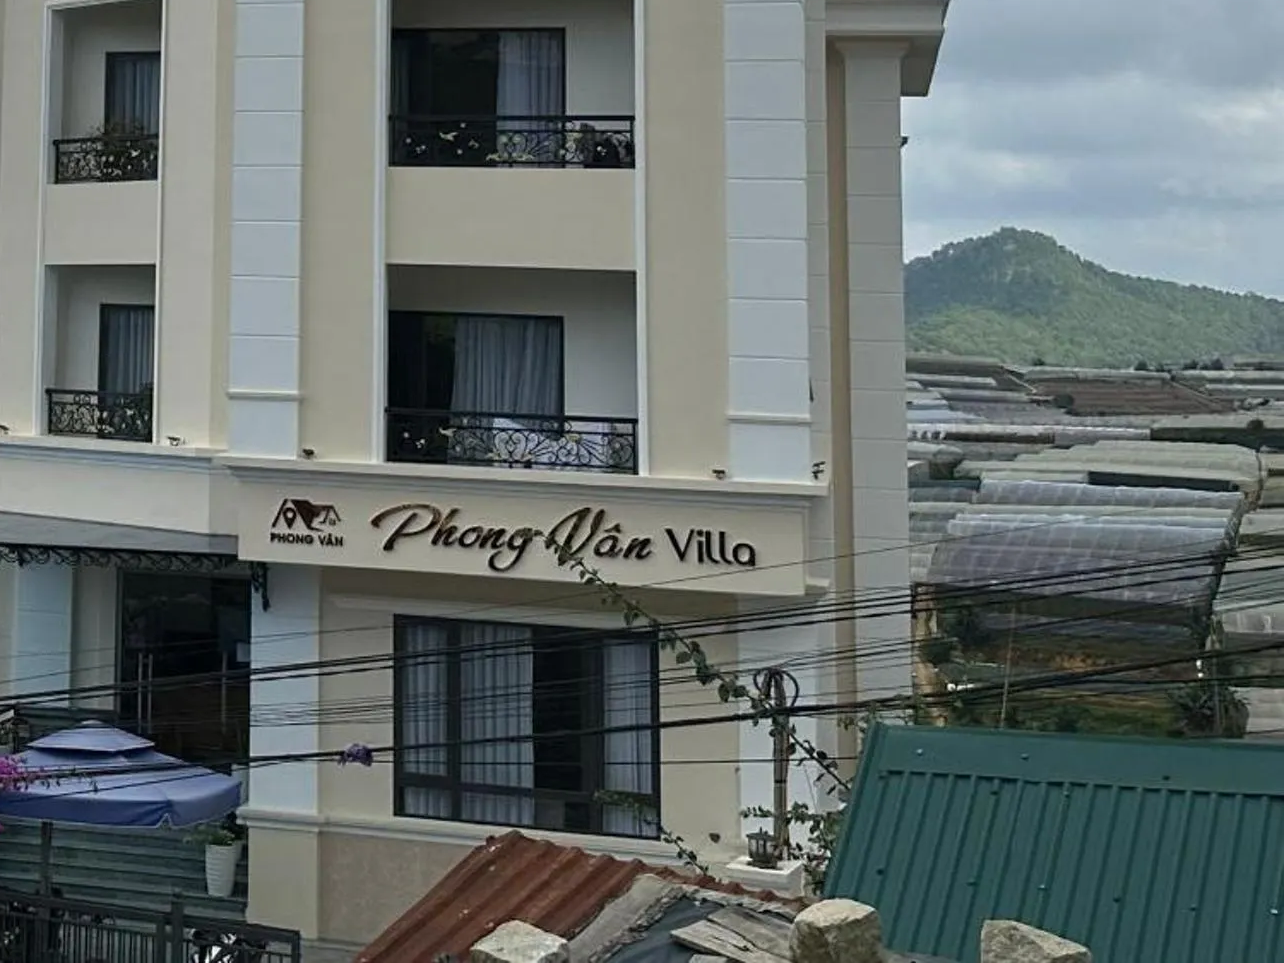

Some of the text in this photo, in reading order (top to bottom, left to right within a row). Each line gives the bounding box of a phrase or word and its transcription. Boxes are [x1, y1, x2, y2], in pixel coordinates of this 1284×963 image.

[270, 532, 344, 547] PHONG VÂN
[370, 503, 533, 573] Phong
[665, 527, 759, 567] Villa
